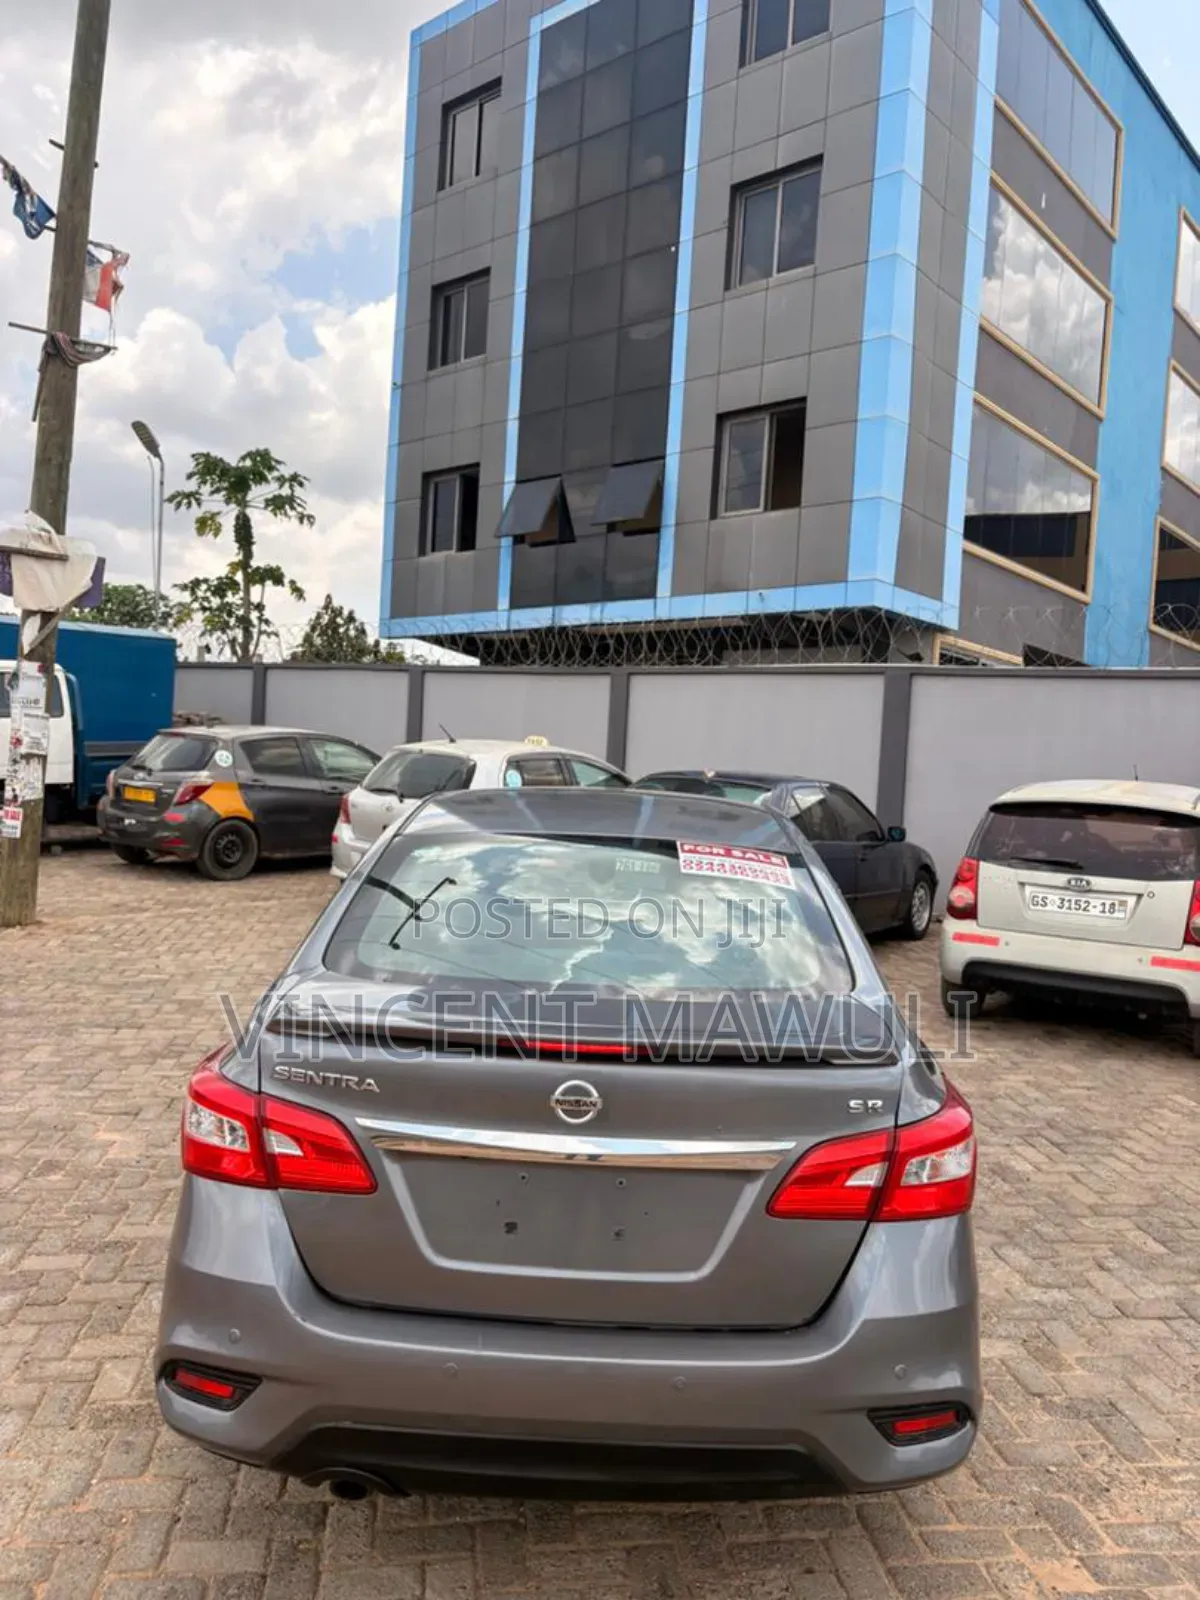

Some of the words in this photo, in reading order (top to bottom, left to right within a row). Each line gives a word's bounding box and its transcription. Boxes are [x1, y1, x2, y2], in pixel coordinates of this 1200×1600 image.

[682, 843, 725, 858] FOR
[731, 848, 787, 867] SALE
[1069, 879, 1088, 889] KIA
[1031, 894, 1049, 909] GS
[1056, 897, 1118, 915] 3152-18
[273, 1065, 380, 1093] SENTRA
[554, 1098, 599, 1108] NISSAN
[848, 1099, 883, 1113] SR
